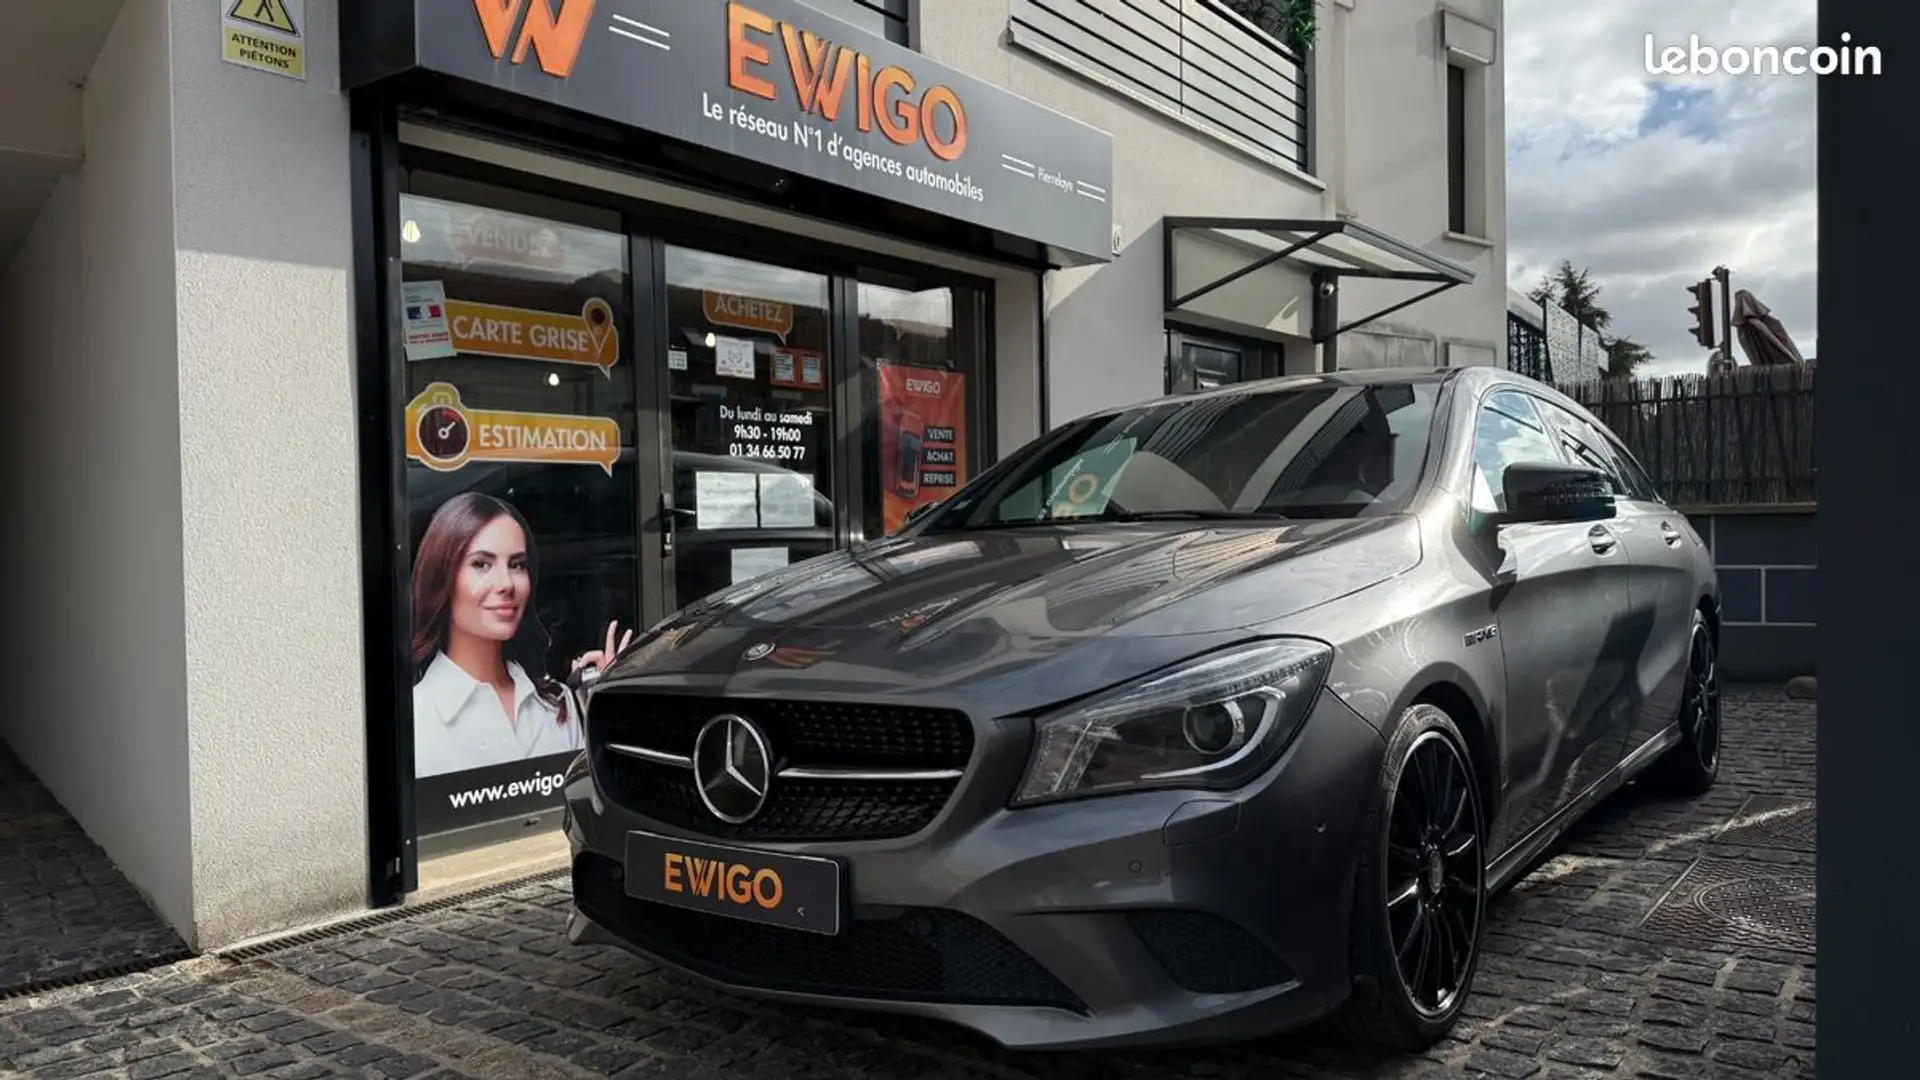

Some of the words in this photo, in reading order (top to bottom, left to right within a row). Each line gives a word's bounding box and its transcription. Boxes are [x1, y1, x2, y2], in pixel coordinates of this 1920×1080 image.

[231, 32, 297, 58] ATTENTION
[239, 46, 290, 69] PIÉTONS
[726, 0, 969, 162] EWIGO
[702, 92, 724, 121] Le
[729, 104, 789, 142] réseau
[793, 121, 823, 153] N°1
[827, 131, 903, 177] d'agences
[905, 164, 985, 201] automobiles
[714, 293, 785, 324] ACHETEZ
[452, 315, 523, 345] CARTE
[529, 323, 590, 352] GRISE
[905, 378, 941, 394] EWIGO
[719, 404, 735, 421] Du
[736, 404, 763, 421] lundi
[764, 412, 777, 422] au
[779, 411, 813, 426] samedi
[479, 423, 607, 451] ESTIMATION
[734, 424, 761, 440] 9h30
[770, 427, 802, 442] 19h00
[927, 427, 954, 441] VENTE
[729, 443, 743, 458] 01
[745, 443, 760, 458] 34
[762, 444, 776, 459] 66
[777, 445, 792, 460] 50
[792, 446, 806, 460] 77
[926, 450, 954, 463] ACHAT
[923, 472, 954, 485] REPRISE
[449, 771, 565, 809] www.ewigo
[664, 852, 783, 909] EWIGO
